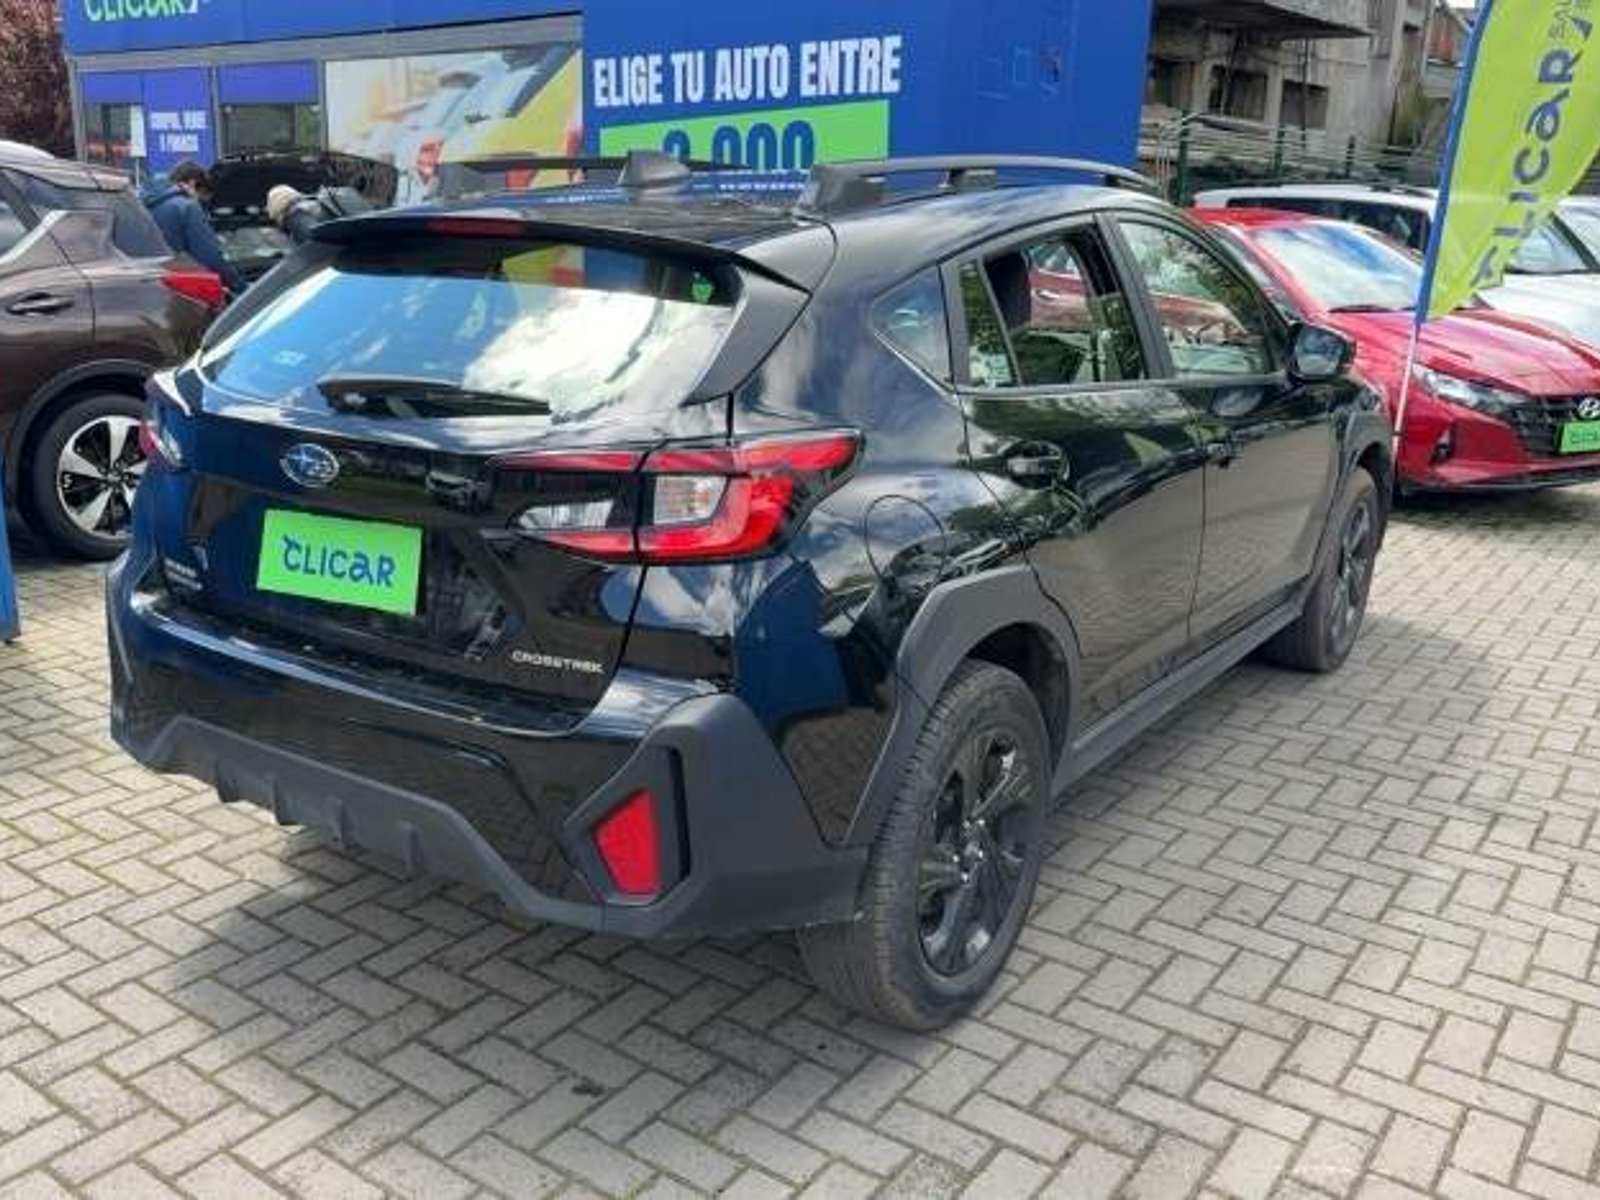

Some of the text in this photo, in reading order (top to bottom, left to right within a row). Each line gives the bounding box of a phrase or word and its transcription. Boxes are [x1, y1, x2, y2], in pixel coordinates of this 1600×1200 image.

[594, 36, 902, 107] ELIGE TU AUTO ENTRE
